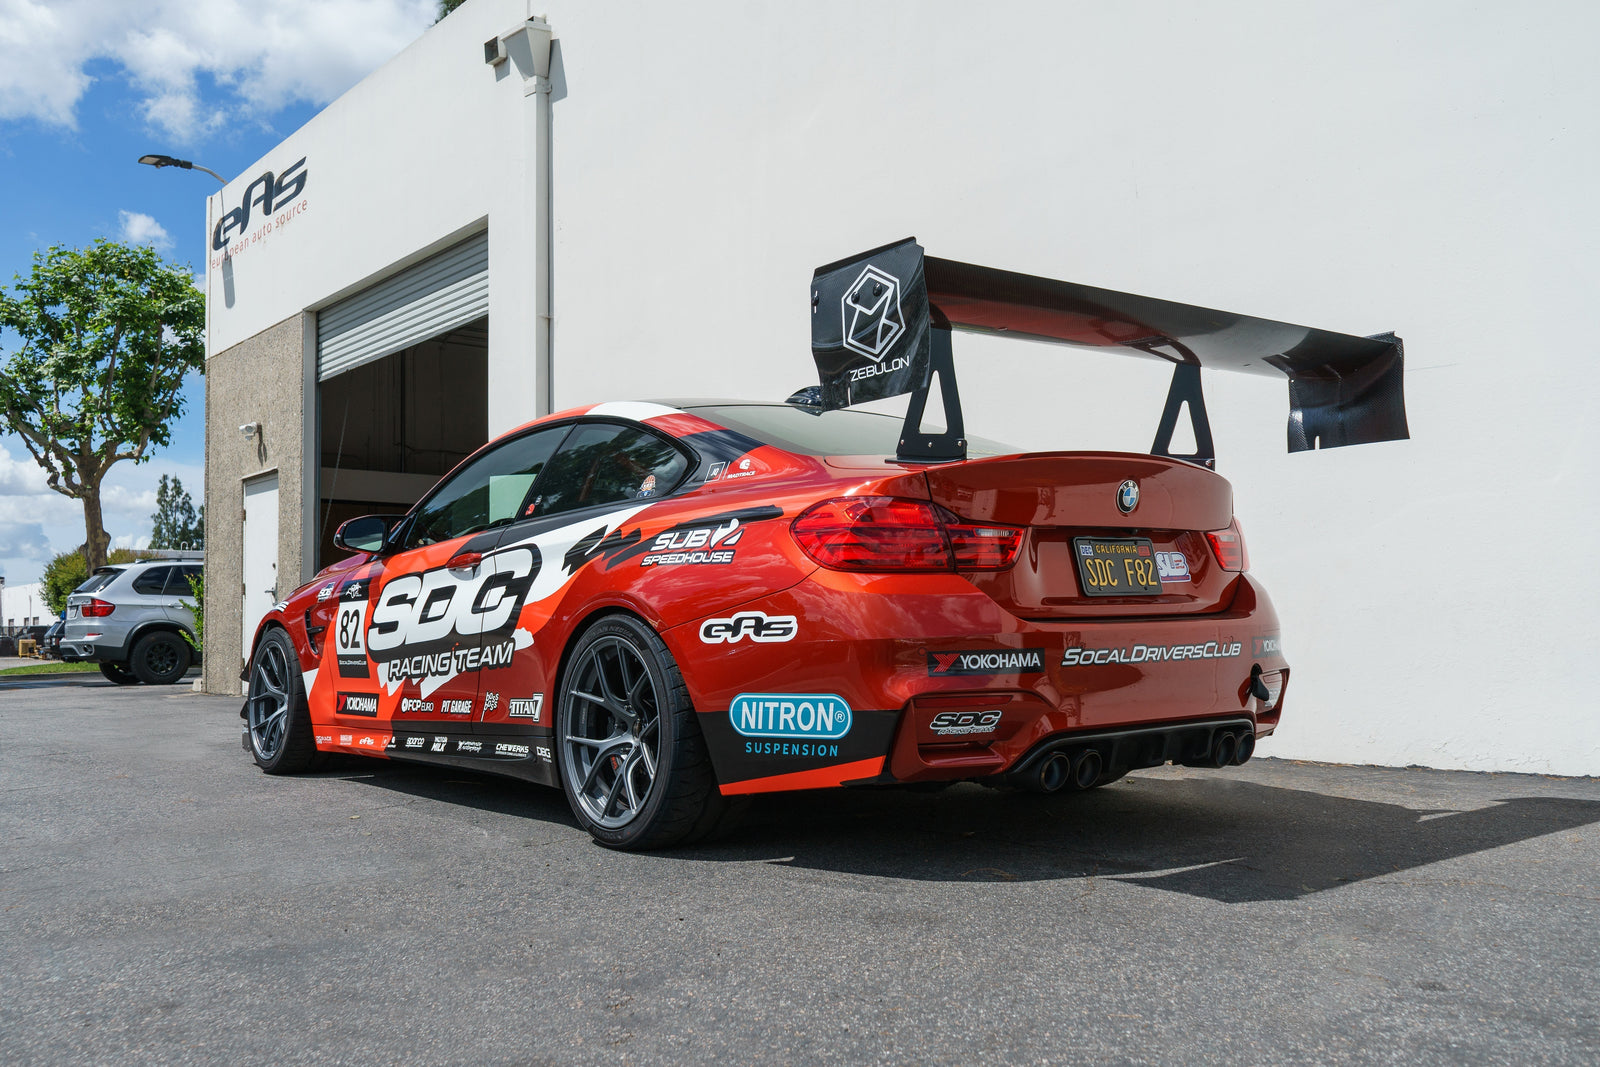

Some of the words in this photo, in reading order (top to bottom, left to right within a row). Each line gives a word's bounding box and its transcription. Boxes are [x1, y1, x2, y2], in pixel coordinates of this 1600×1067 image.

[212, 156, 308, 251] eAS
[211, 237, 249, 269] european
[252, 222, 272, 243] auto
[276, 199, 307, 229] source
[850, 355, 910, 382] ZEBULON
[1095, 545, 1137, 554] CALIFORNIA
[641, 551, 734, 566] SPEEDHOUSE
[1085, 558, 1118, 586] SDC
[1124, 558, 1158, 586] F82
[340, 609, 361, 649] 82
[389, 652, 451, 678] RACING
[453, 641, 515, 670] TEAM
[960, 652, 1041, 669] YOKOHAMA
[346, 696, 377, 713] YOKOHAMA
[408, 699, 422, 711] FCP
[421, 701, 434, 712] EURO
[440, 700, 450, 713] PIT
[450, 700, 472, 714] GARAGE
[496, 743, 529, 753] CHEWERKS
[745, 742, 838, 757] SUSPENSION
